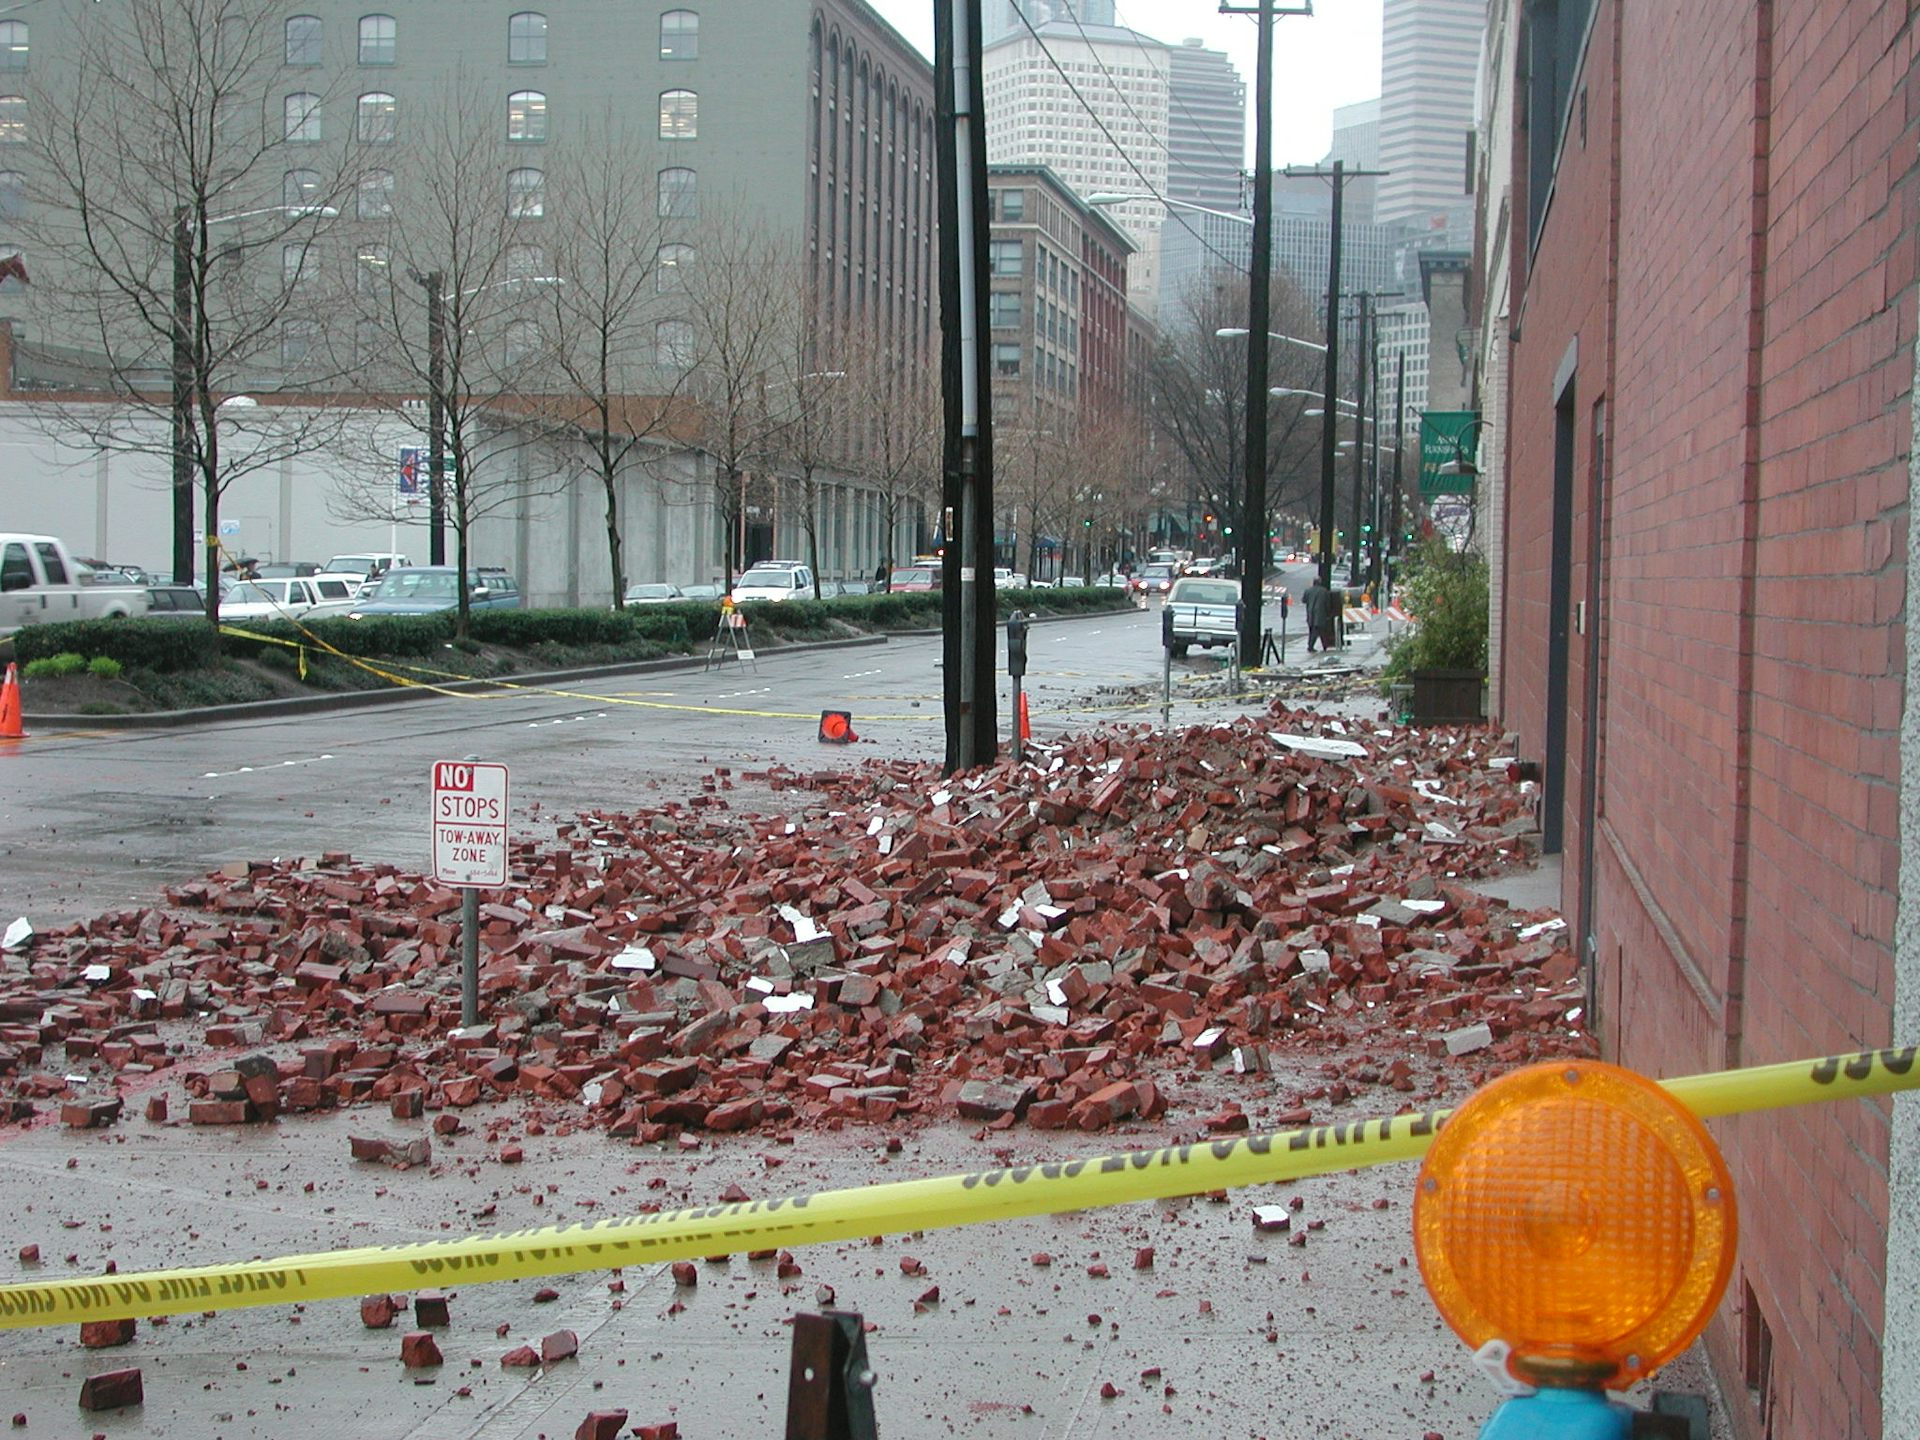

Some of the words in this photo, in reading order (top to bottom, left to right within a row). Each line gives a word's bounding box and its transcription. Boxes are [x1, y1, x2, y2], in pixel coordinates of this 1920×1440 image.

[440, 764, 469, 788] NO
[441, 796, 499, 819] STOPS
[440, 829, 500, 846] TOW-AWAY
[452, 847, 486, 863] ZONE
